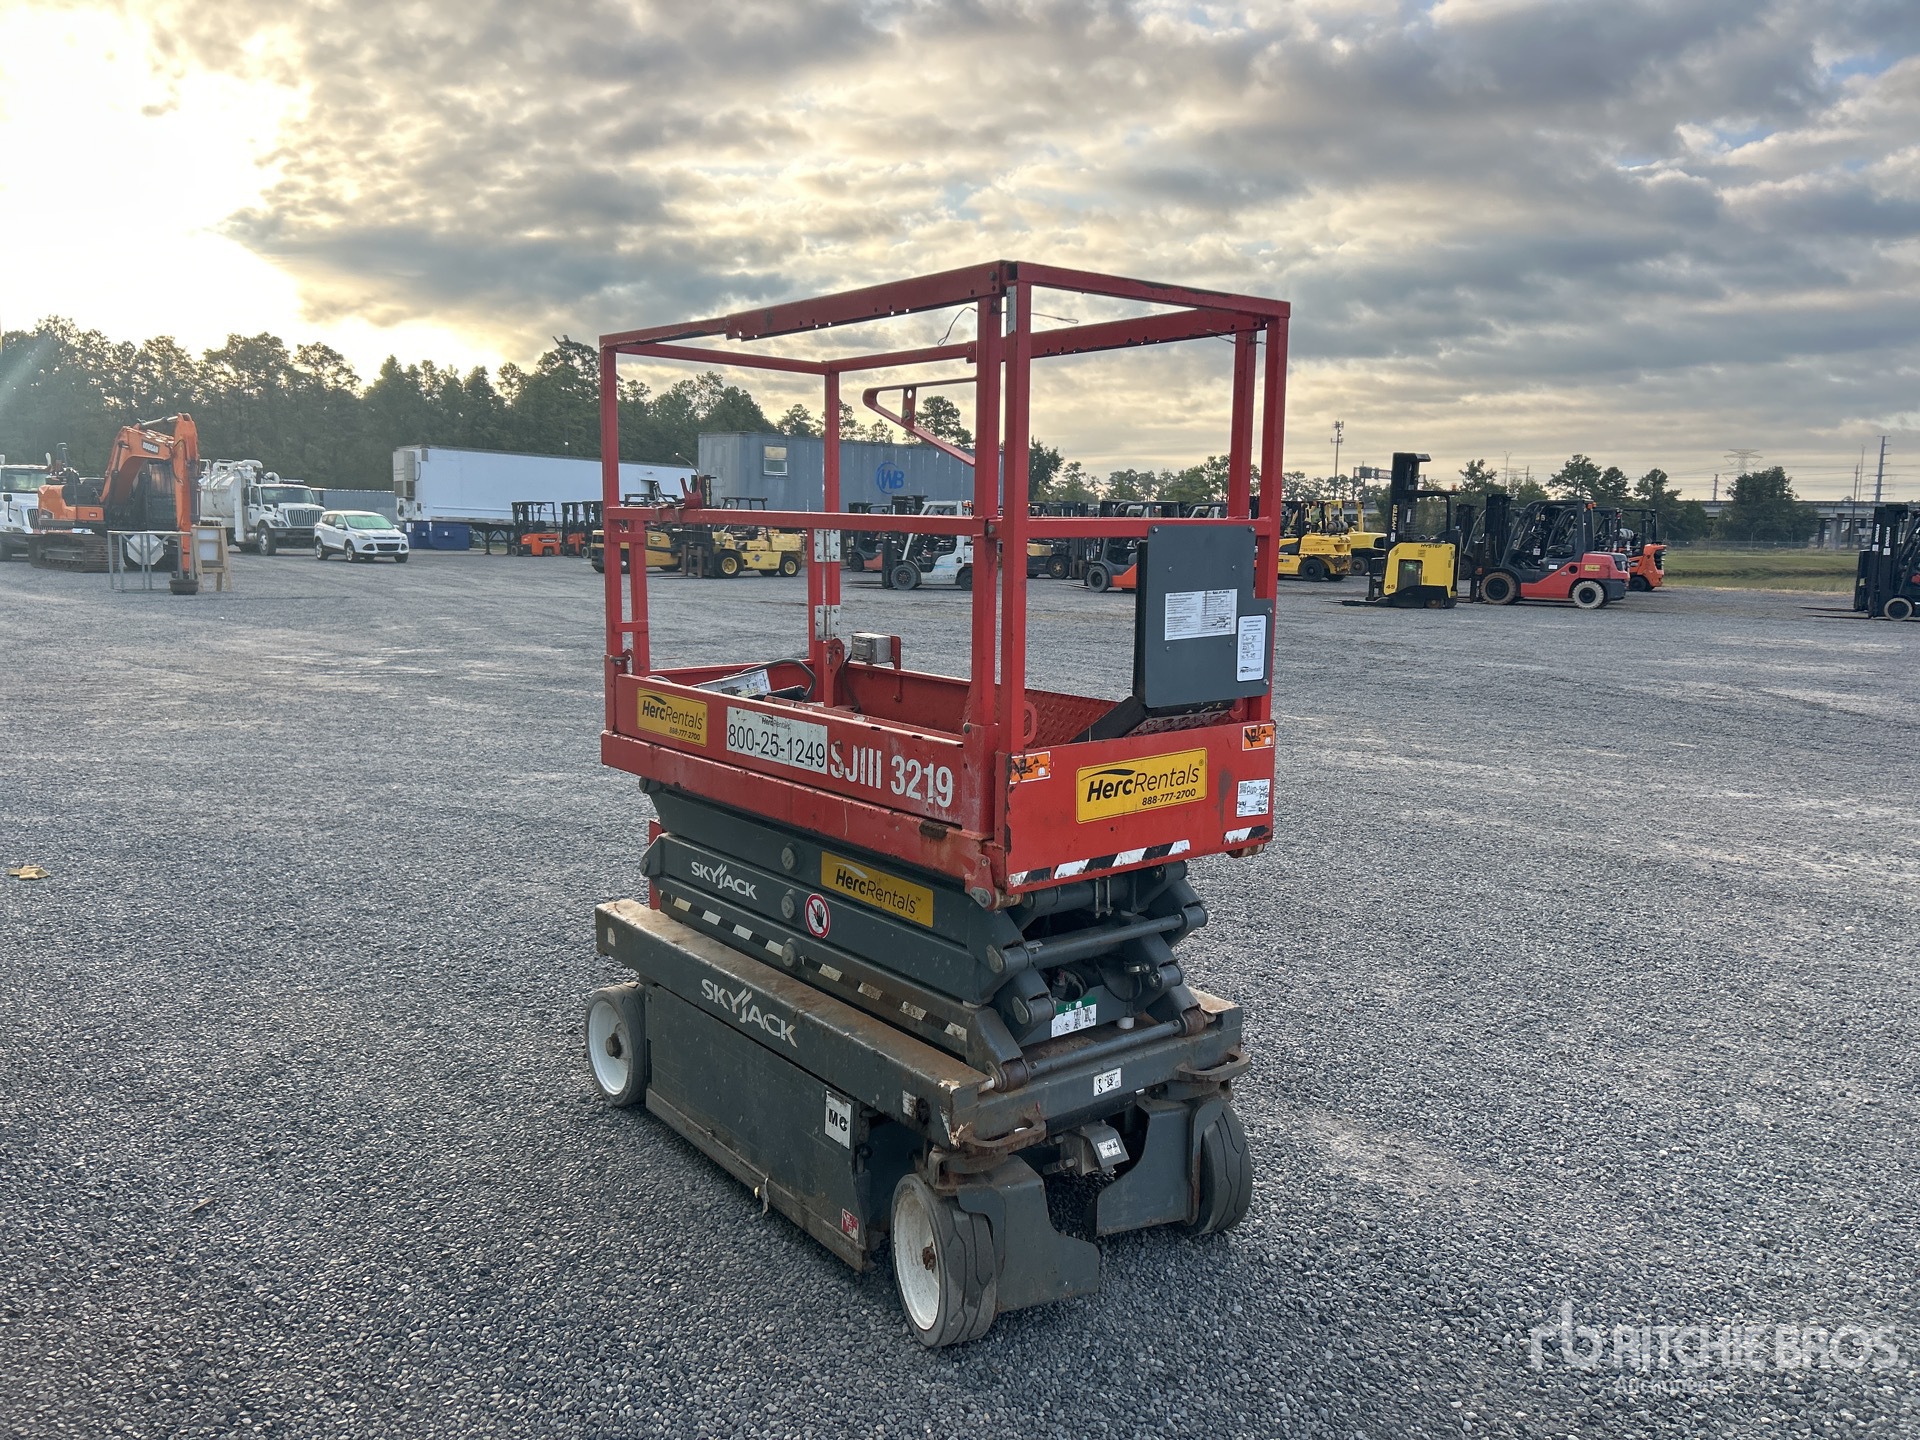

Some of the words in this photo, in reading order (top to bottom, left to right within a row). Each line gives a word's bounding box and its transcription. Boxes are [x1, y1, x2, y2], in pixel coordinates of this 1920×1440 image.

[881, 469, 905, 490] WB
[1391, 504, 1399, 531] HYSTER
[668, 726, 701, 741] 888-777-2700
[728, 723, 826, 769] 800-25-1249
[890, 755, 954, 809] 3219
[1141, 788, 1197, 807] 888-777-2700
[691, 860, 758, 900] SKYJACK
[701, 978, 798, 1049] SKYJACK
